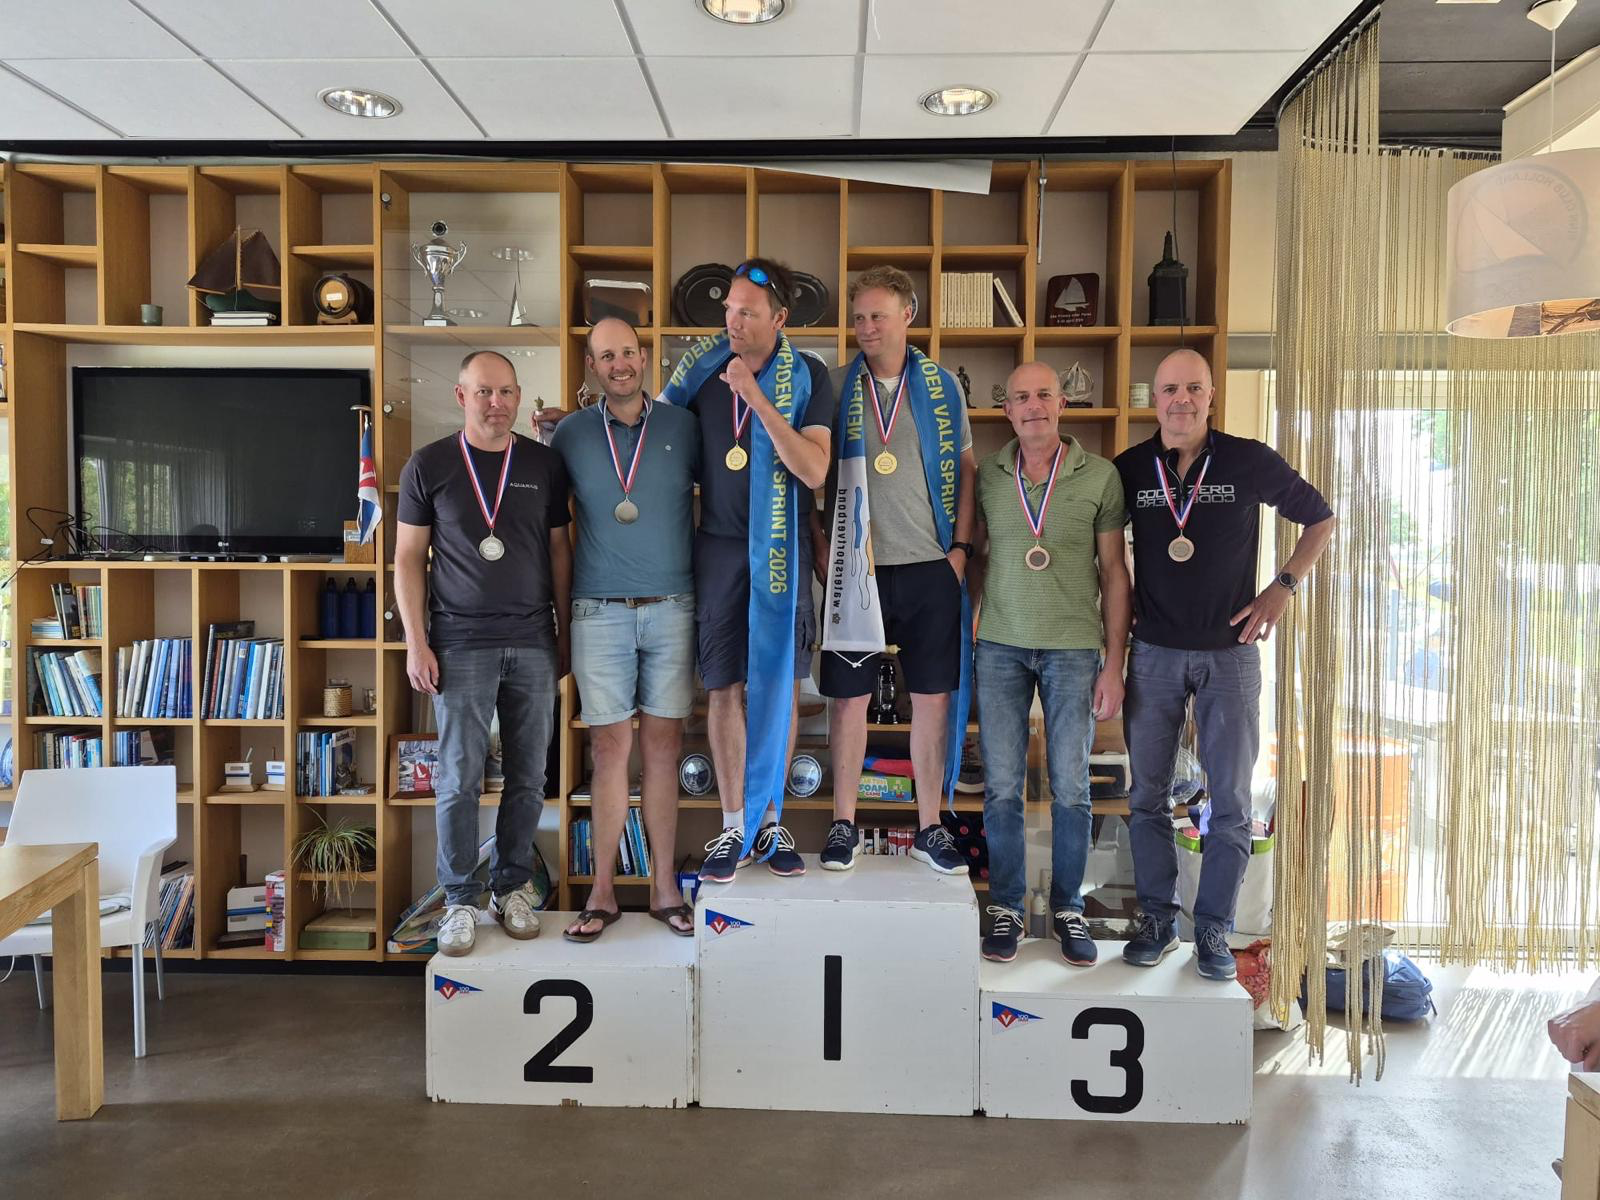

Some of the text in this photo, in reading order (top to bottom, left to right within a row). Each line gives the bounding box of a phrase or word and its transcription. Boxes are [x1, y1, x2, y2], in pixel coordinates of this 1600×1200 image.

[933, 404, 954, 455] VALK
[771, 471, 787, 541] SPRINT
[768, 547, 788, 594] 2026
[713, 921, 725, 932] V
[442, 986, 454, 998] V
[523, 979, 594, 1083] 2
[1001, 1014, 1013, 1026] V
[1070, 1006, 1145, 1114] 3
